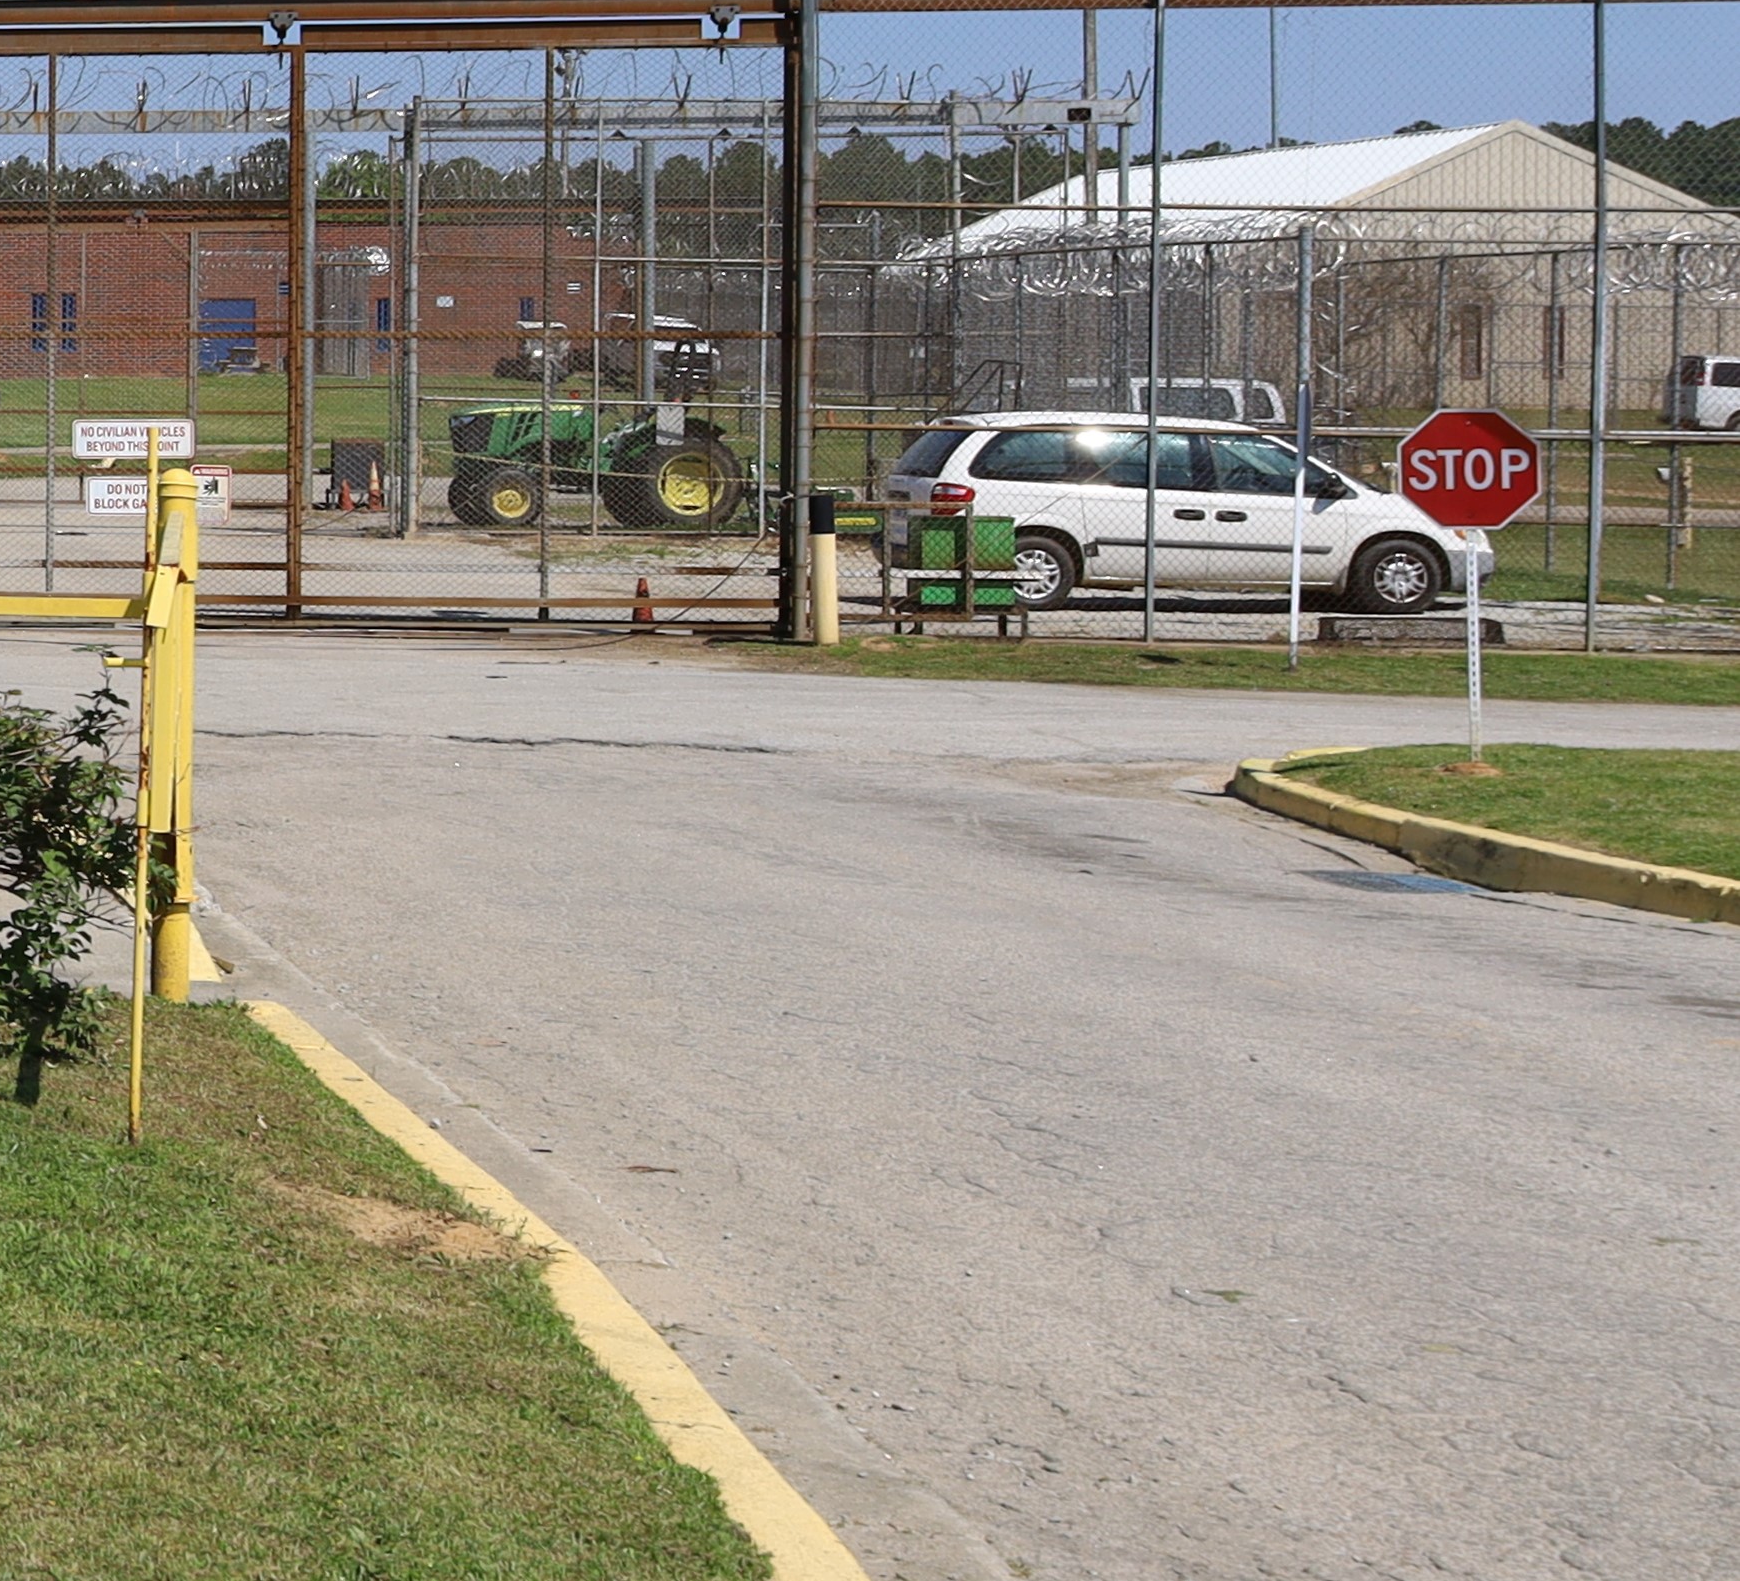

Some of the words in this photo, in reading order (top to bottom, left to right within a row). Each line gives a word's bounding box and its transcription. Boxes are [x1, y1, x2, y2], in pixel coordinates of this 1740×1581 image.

[81, 426, 94, 437] NO
[96, 426, 137, 437] CIVILIAN
[86, 441, 125, 452] BEYOND
[127, 441, 149, 452] THIS
[157, 441, 180, 452] OINT
[1408, 448, 1530, 491] STOP
[107, 483, 122, 495] DO
[124, 483, 147, 495] NOT
[94, 498, 130, 509] BLOCK
[132, 498, 148, 509] GA
